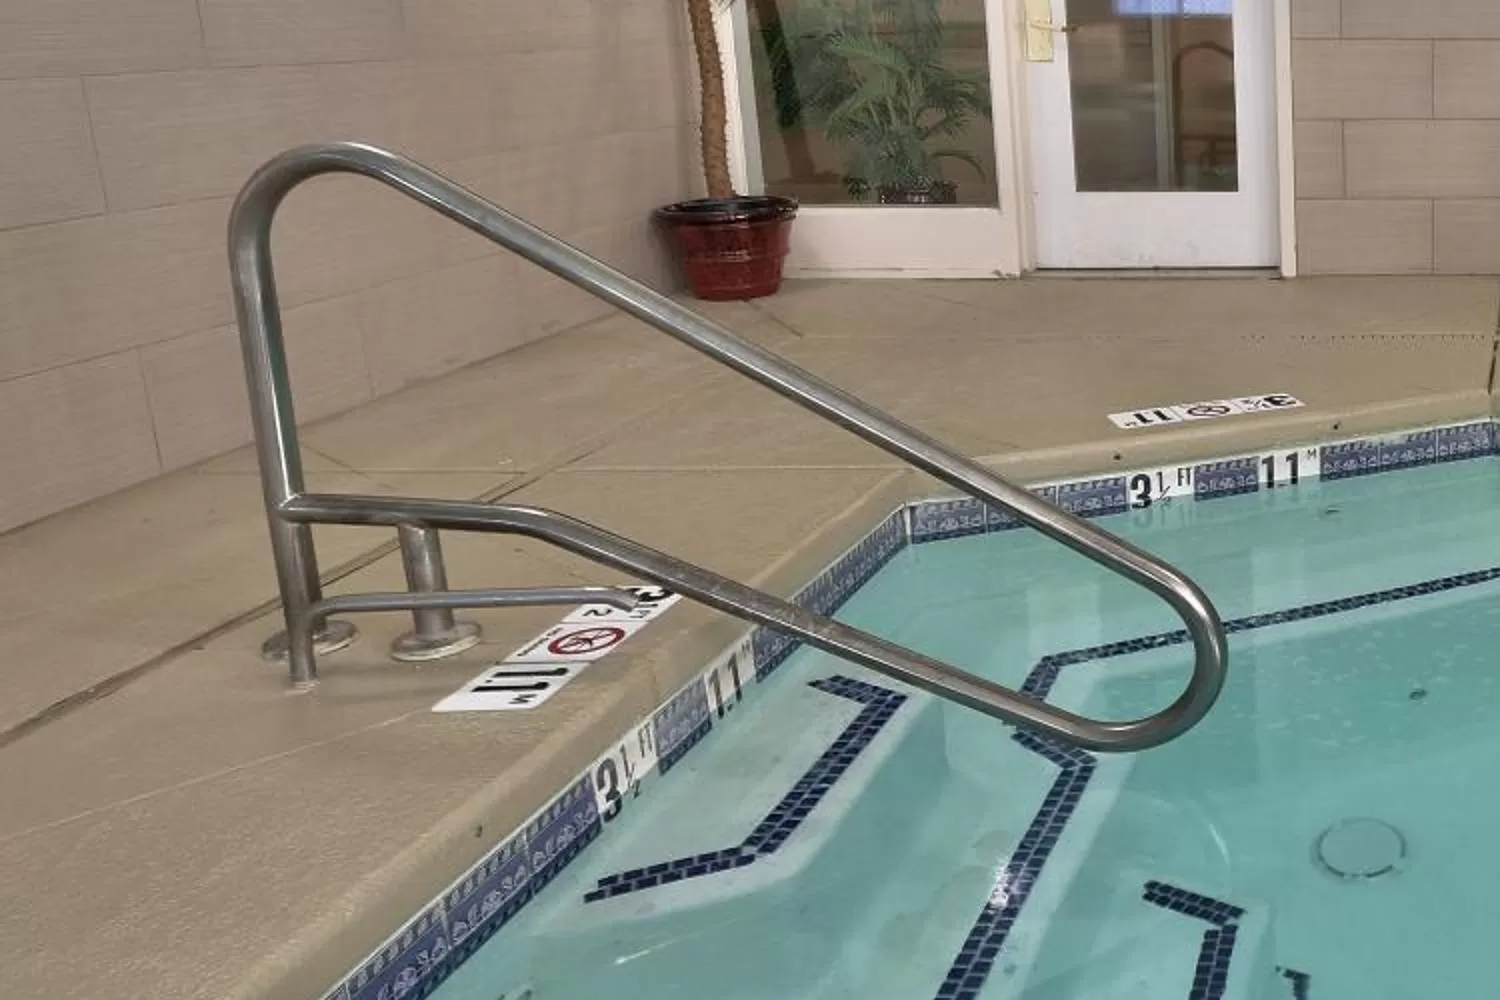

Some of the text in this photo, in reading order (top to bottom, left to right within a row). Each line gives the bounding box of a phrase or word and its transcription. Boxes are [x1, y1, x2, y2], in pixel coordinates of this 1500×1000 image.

[1131, 473, 1152, 509] 3
[1177, 467, 1191, 487] FT
[471, 667, 569, 693] 1.1
[596, 757, 623, 822] 3
